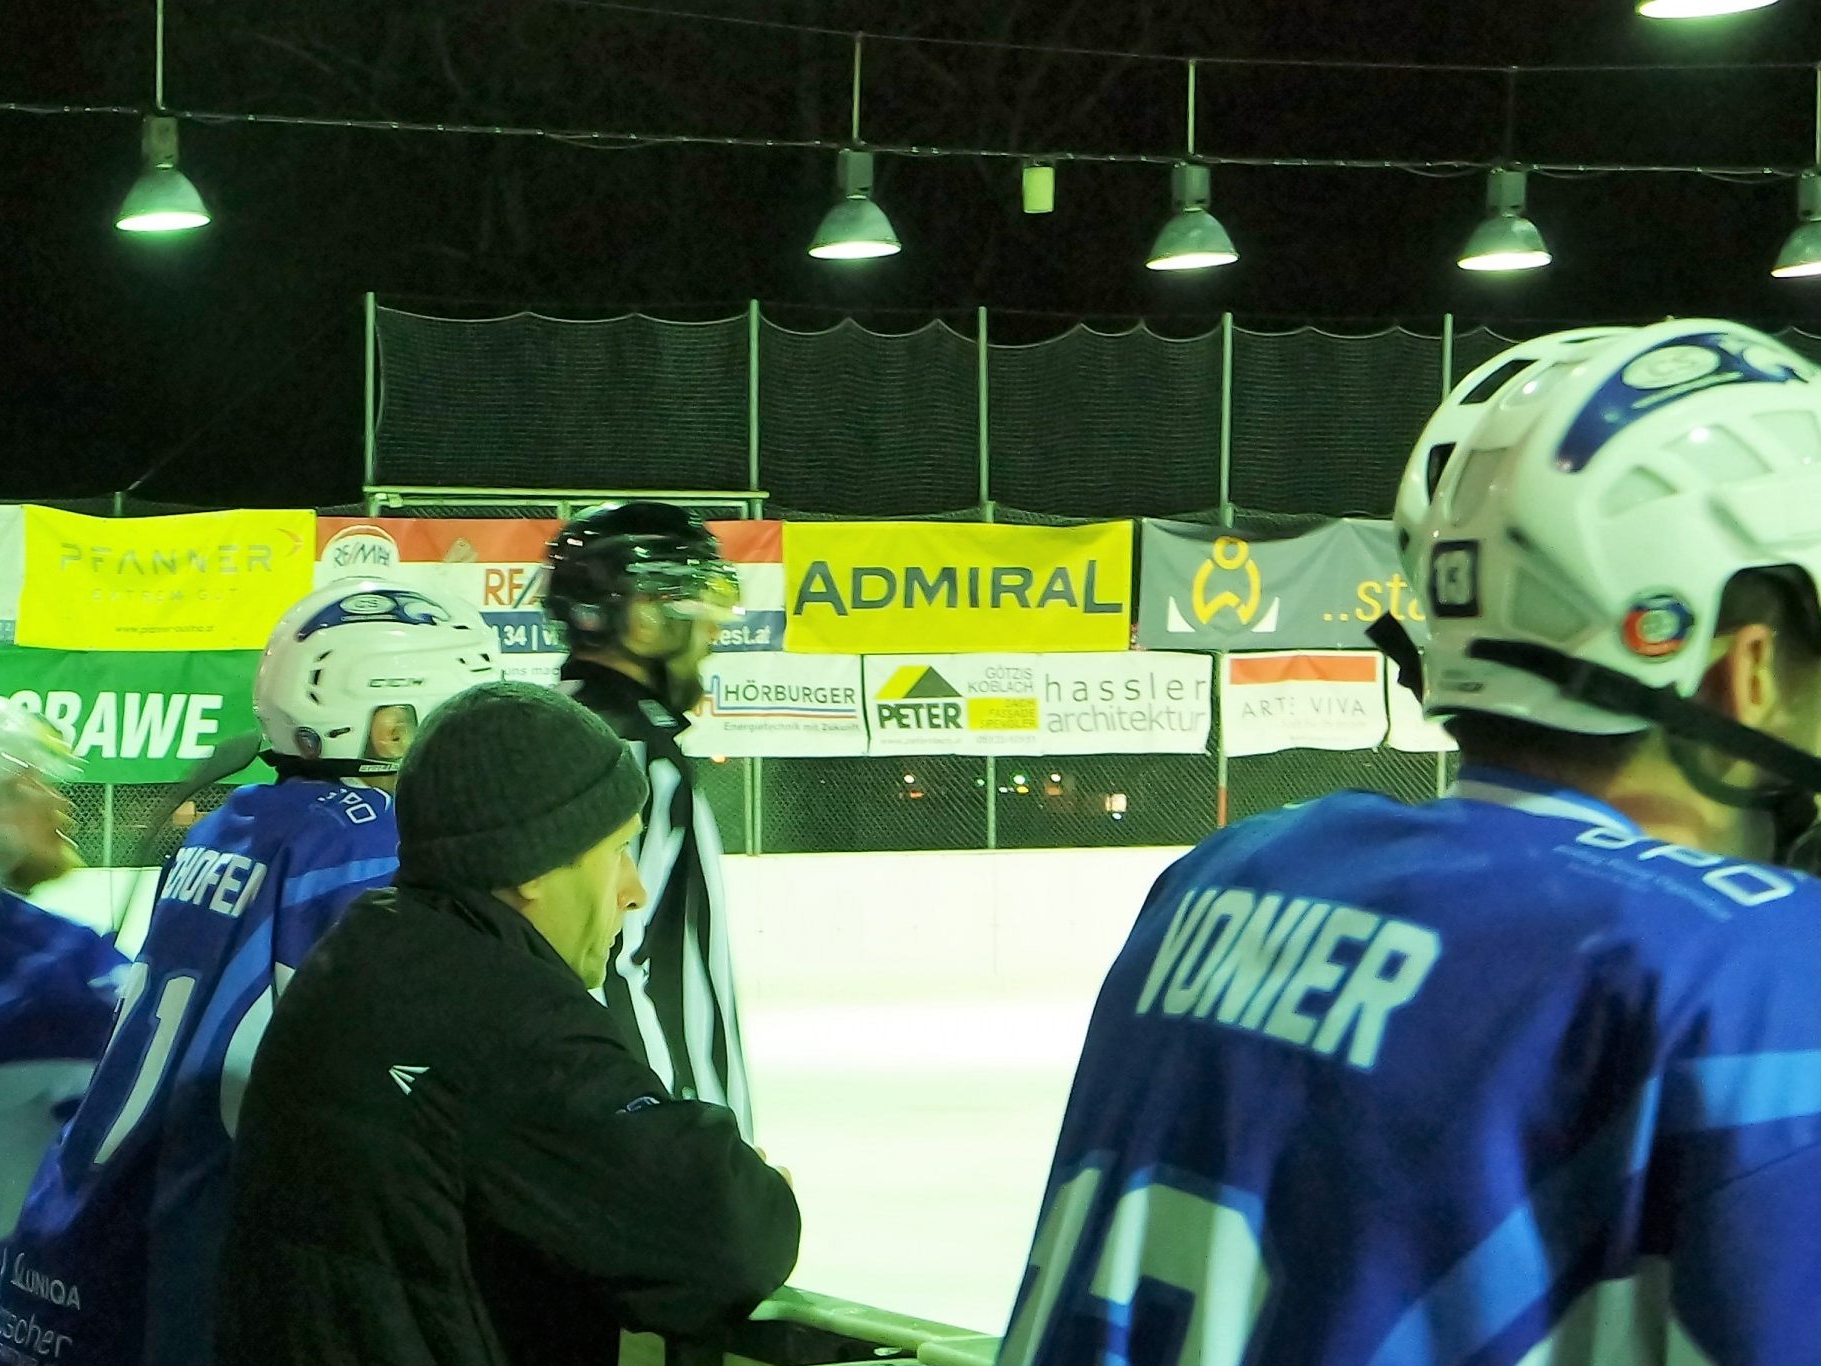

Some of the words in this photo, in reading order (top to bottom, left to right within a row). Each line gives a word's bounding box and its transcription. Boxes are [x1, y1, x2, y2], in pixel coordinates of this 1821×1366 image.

[60, 542, 272, 575] PFANNER
[792, 558, 1123, 616] ADMIRAL
[724, 680, 856, 704] HÖRBURGER
[968, 680, 1034, 693] KOBLACH
[1045, 672, 1207, 702] hassler
[877, 702, 964, 729] PETER
[1047, 703, 1206, 734] architektur
[1309, 696, 1367, 717] VIVA
[1137, 885, 1442, 1073] VONIER
